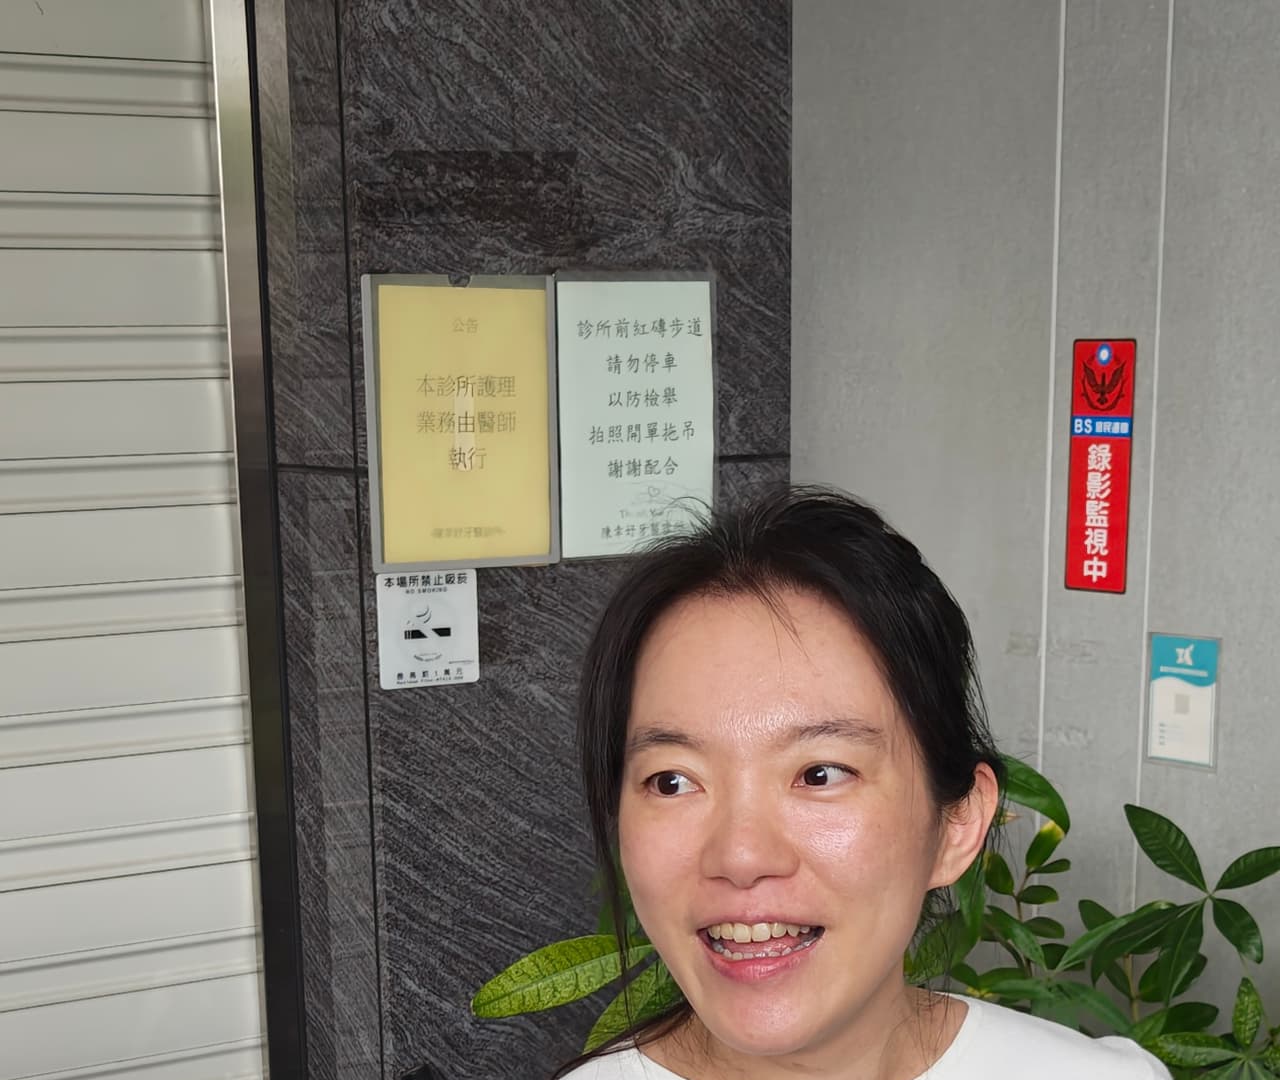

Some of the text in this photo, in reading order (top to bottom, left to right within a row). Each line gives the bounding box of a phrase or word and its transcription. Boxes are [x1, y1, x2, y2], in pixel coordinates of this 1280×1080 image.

[452, 318, 479, 333] 公告
[577, 317, 703, 340] 診所前紅磚步道
[606, 352, 678, 375] 請勿停車
[417, 373, 516, 397] 本診所護理
[608, 387, 678, 408] 以防檢舉
[417, 410, 517, 434] 業務由醫師
[589, 421, 695, 444] 拍照開單拖吊
[1074, 418, 1093, 434] BS
[448, 447, 488, 471] 執行
[607, 456, 679, 479] 謝謝配合
[1083, 443, 1113, 583] 錄影監視中
